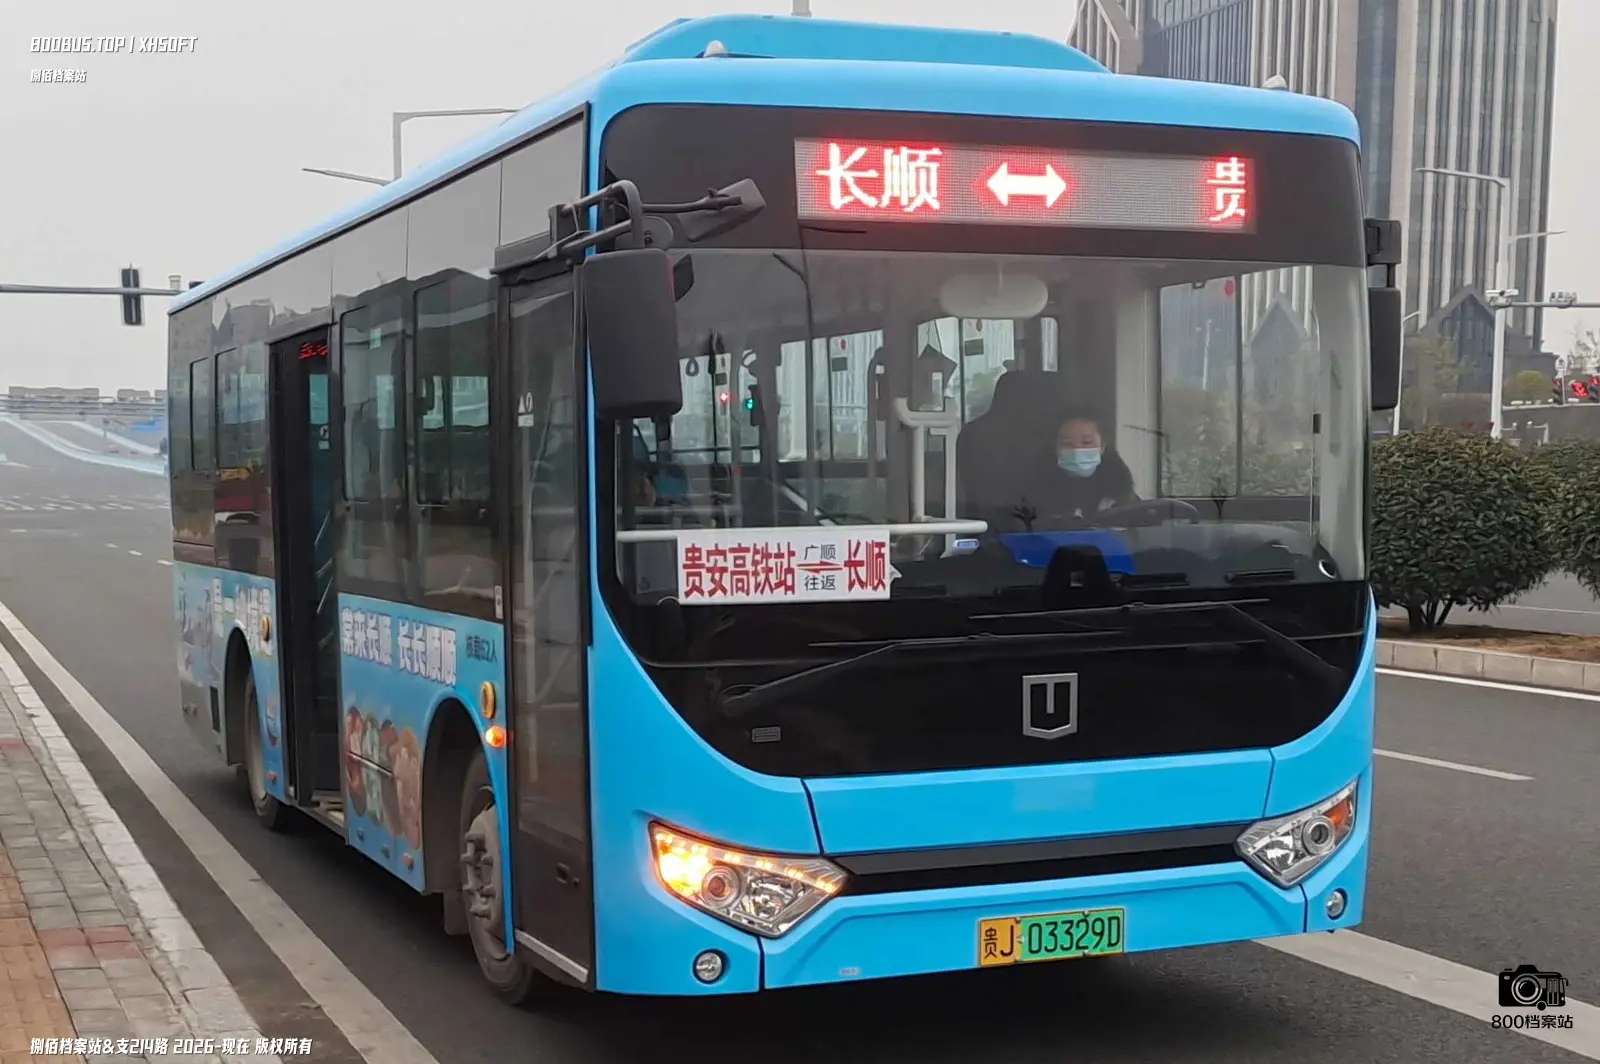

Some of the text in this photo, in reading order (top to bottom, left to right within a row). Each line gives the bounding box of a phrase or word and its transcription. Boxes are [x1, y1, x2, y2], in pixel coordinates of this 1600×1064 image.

[815, 142, 943, 213] 长顺
[682, 541, 797, 599] 贵安高铁站
[803, 543, 837, 561] 广顺
[843, 538, 887, 592] 长顺
[803, 574, 837, 592] 往返
